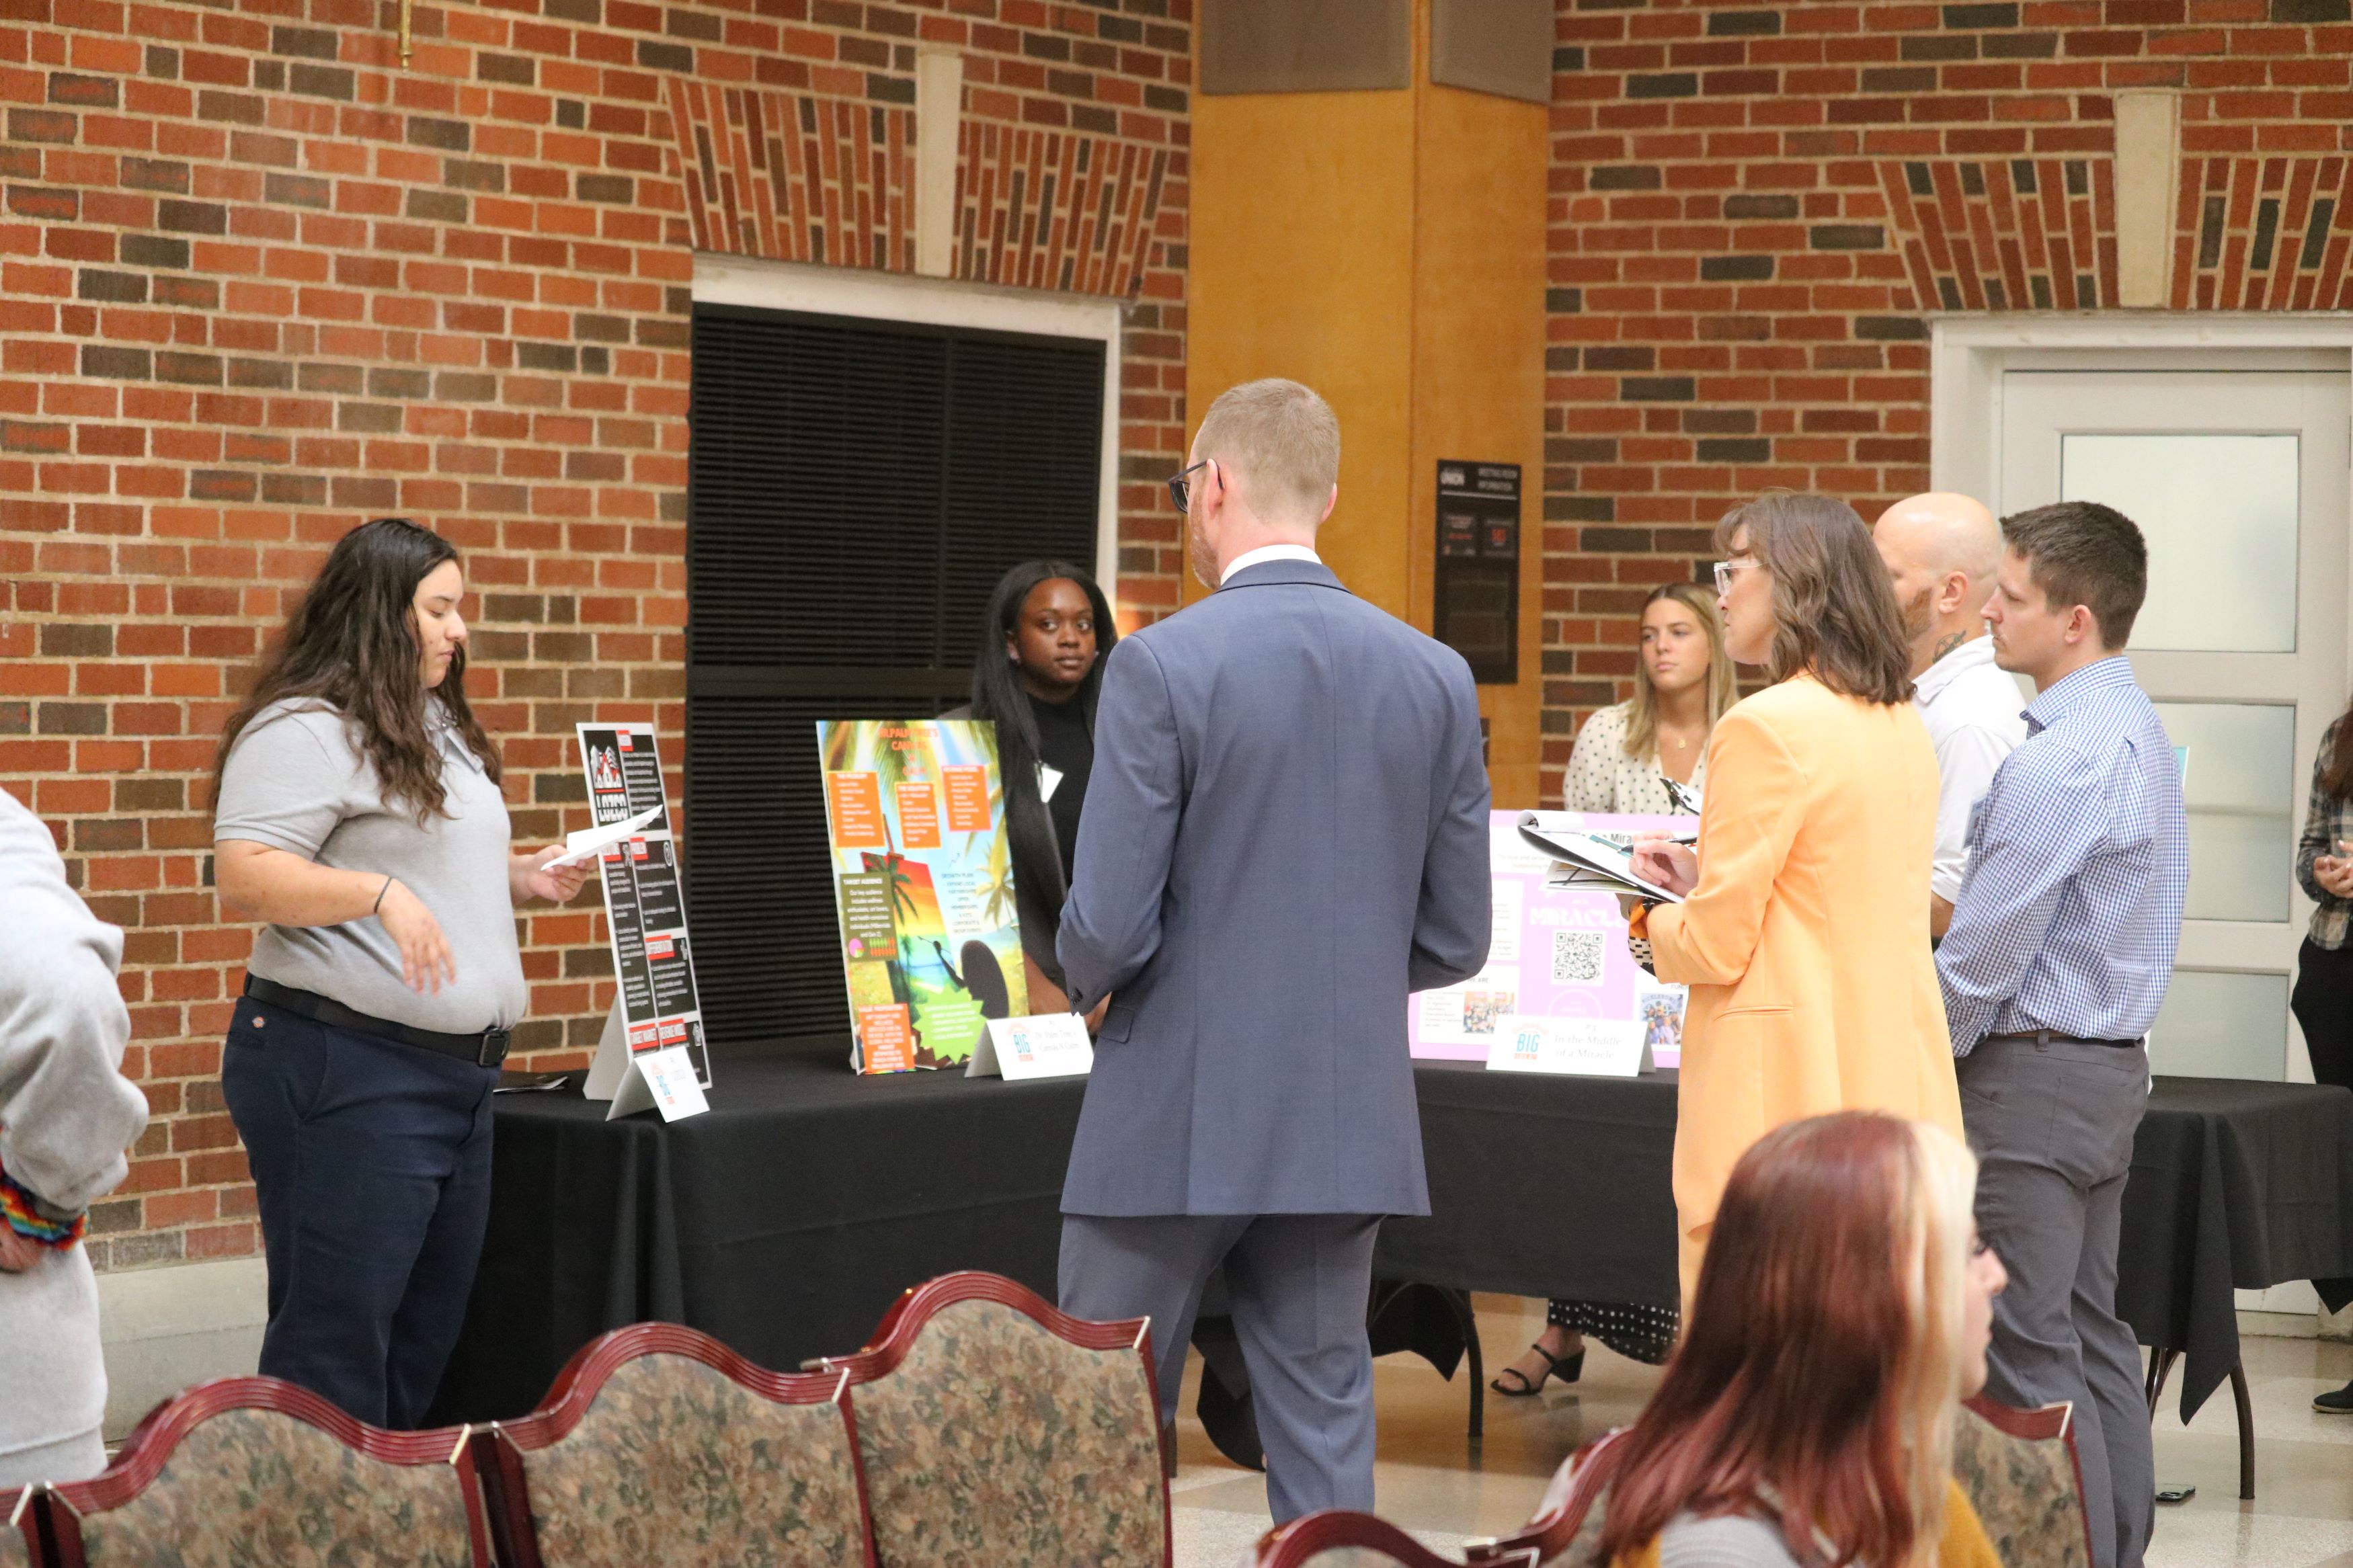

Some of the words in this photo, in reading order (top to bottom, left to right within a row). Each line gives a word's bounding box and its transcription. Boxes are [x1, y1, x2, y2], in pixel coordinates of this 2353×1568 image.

[1012, 1033, 1031, 1054] BIG
[1516, 1033, 1540, 1052] BIG
[1554, 1035, 1564, 1044] In
[1567, 1035, 1584, 1044] the
[1587, 1036, 1622, 1046] Middle
[1556, 1048, 1566, 1057] of
[1577, 1049, 1615, 1060] Miracle
